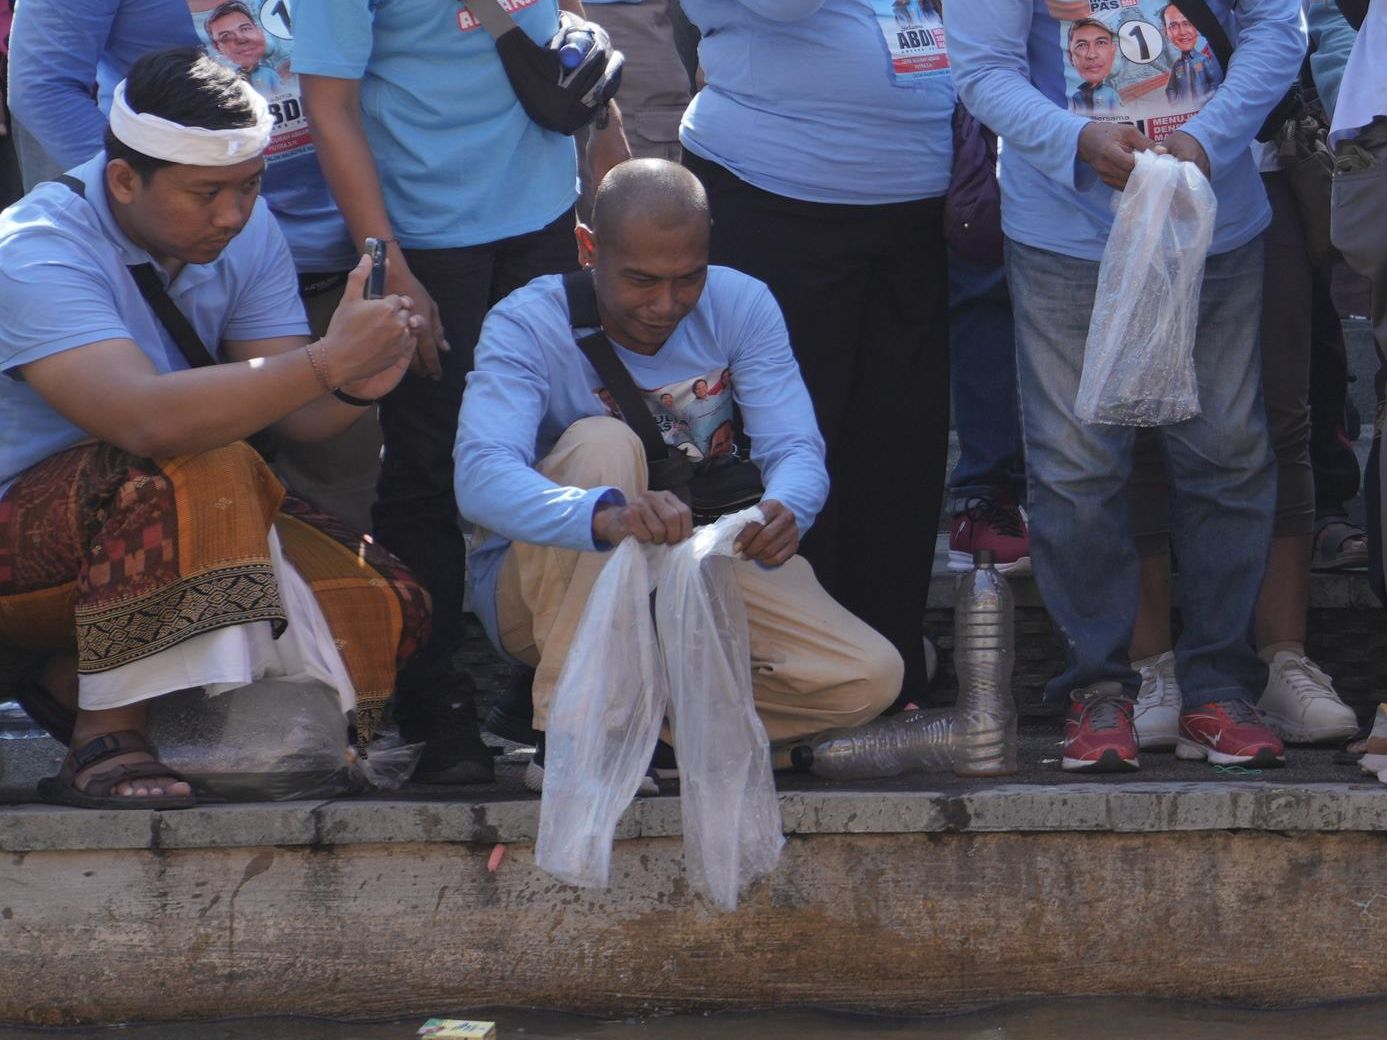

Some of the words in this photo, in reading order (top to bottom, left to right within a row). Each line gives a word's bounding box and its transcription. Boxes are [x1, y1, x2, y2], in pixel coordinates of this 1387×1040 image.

[271, 0, 293, 36] 1
[1091, 0, 1120, 12] PAS
[896, 29, 935, 50] ABDI
[1127, 25, 1151, 60] 1
[268, 97, 305, 126] BD
